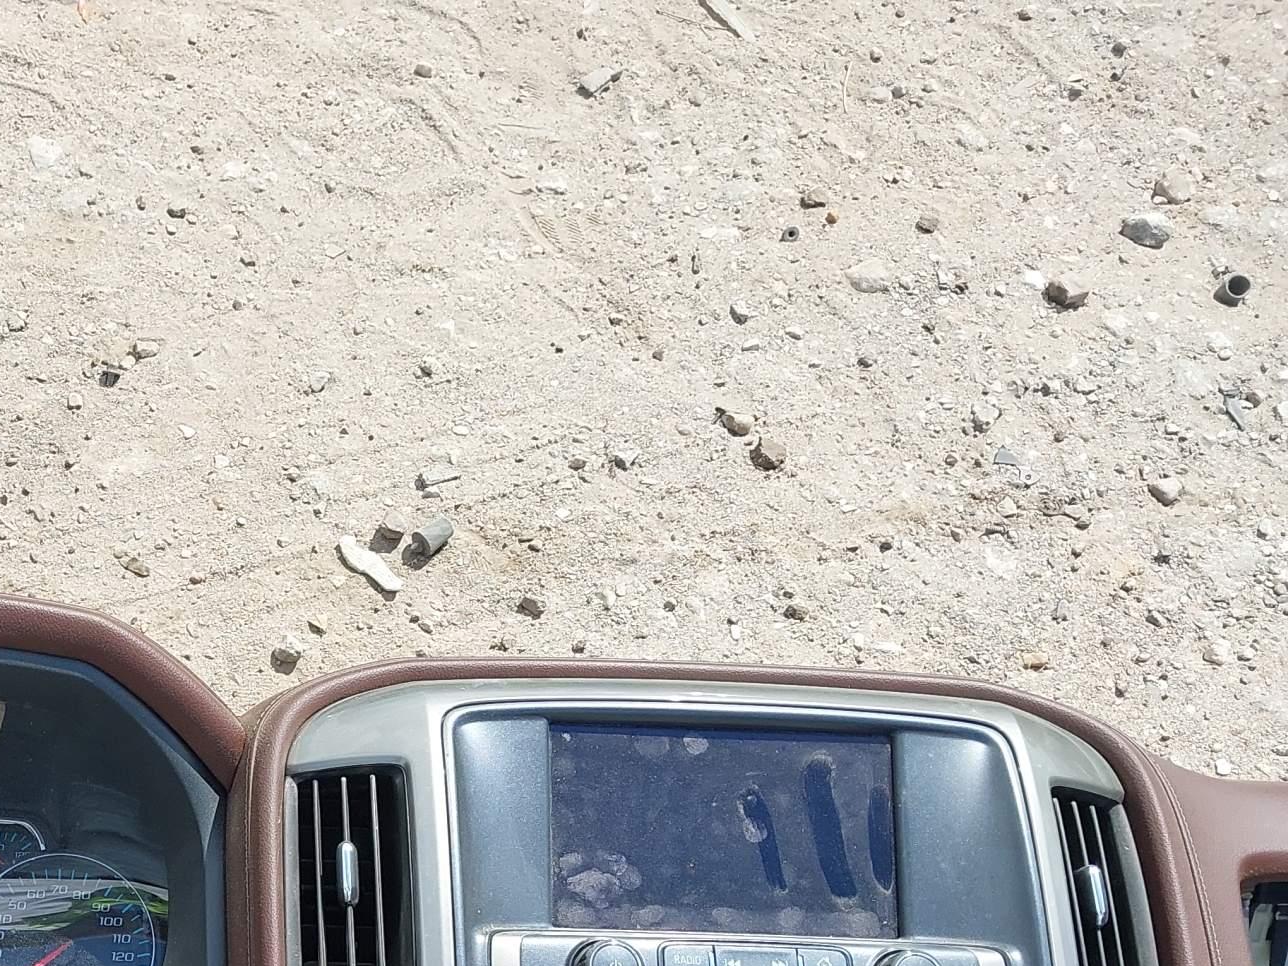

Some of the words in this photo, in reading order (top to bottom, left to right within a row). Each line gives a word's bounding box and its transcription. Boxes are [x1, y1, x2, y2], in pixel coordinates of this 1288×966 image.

[51, 885, 68, 894] 70
[26, 890, 46, 899] 60
[72, 891, 91, 899] 80
[8, 902, 27, 910] 50
[92, 904, 110, 913] 90
[100, 917, 123, 927] 100
[112, 934, 131, 944] 110
[111, 952, 134, 961] 120
[674, 955, 702, 966] RADIO
